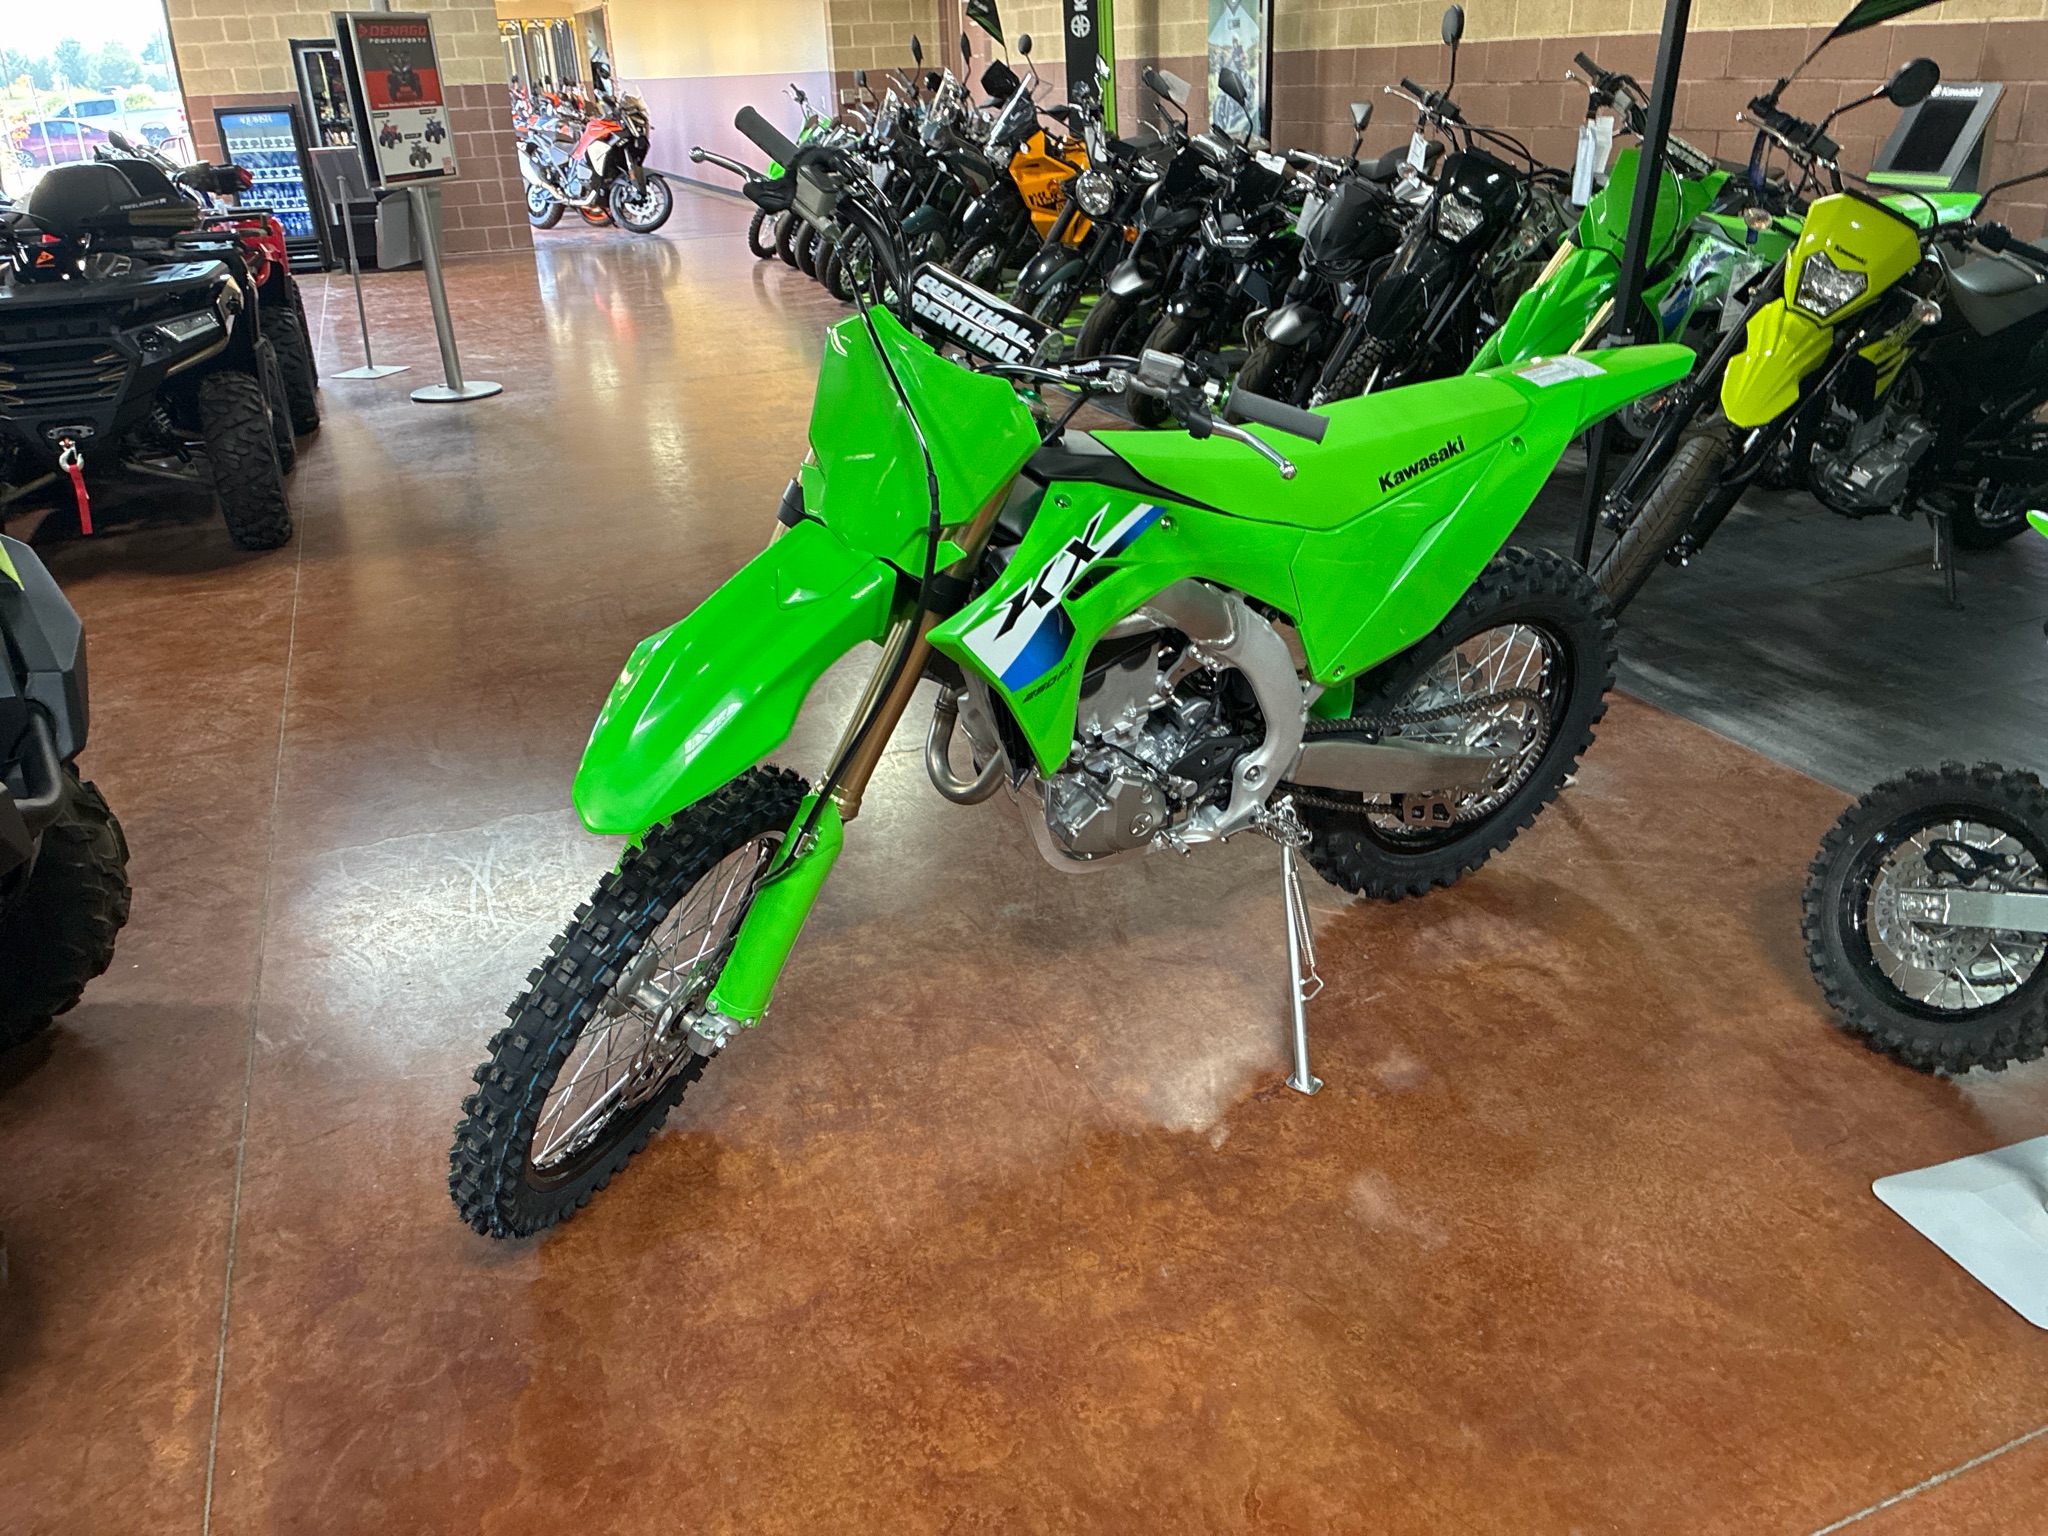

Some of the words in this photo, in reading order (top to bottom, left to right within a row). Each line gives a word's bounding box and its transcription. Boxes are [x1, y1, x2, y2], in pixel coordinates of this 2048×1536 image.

[368, 24, 428, 37] DENAGO
[1941, 86, 1984, 97] Kawasaki
[912, 291, 1022, 365] RENTHAL
[915, 274, 1035, 349] RENTHAL
[1378, 434, 1465, 493] Kawasaki
